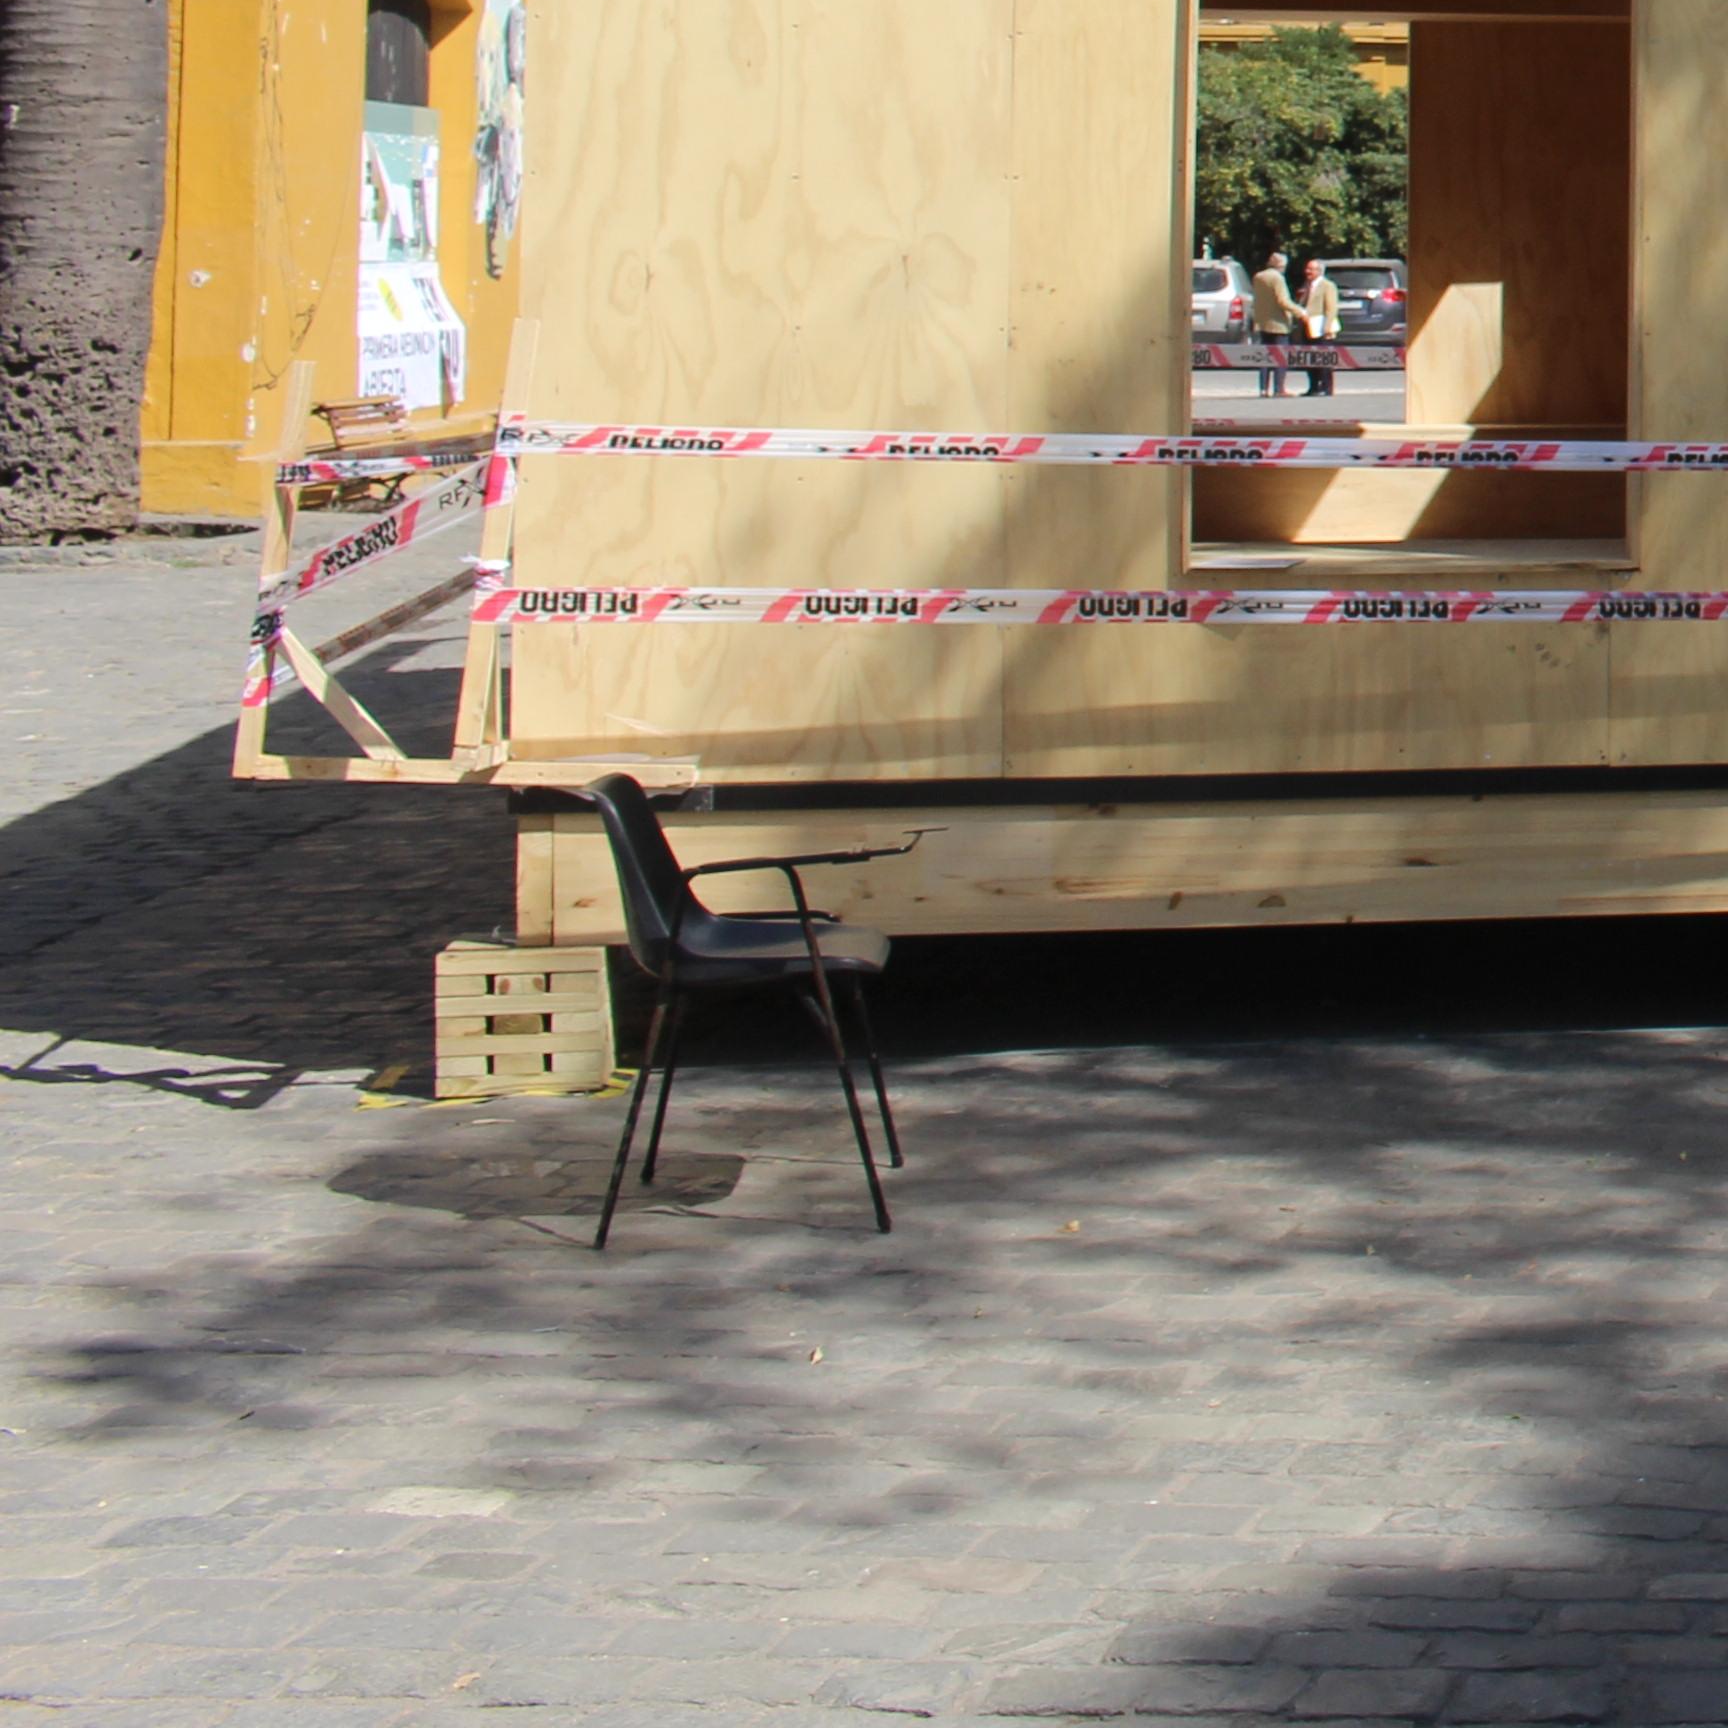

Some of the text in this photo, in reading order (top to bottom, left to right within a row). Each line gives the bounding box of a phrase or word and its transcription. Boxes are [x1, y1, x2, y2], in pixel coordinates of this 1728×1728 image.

[520, 591, 637, 614] PELIGRO
[806, 595, 918, 616] PELIGRO
[1079, 598, 1188, 618] PELIGRO
[1344, 599, 1448, 619] PELIGRO
[1600, 601, 1700, 619] PELIGRO
